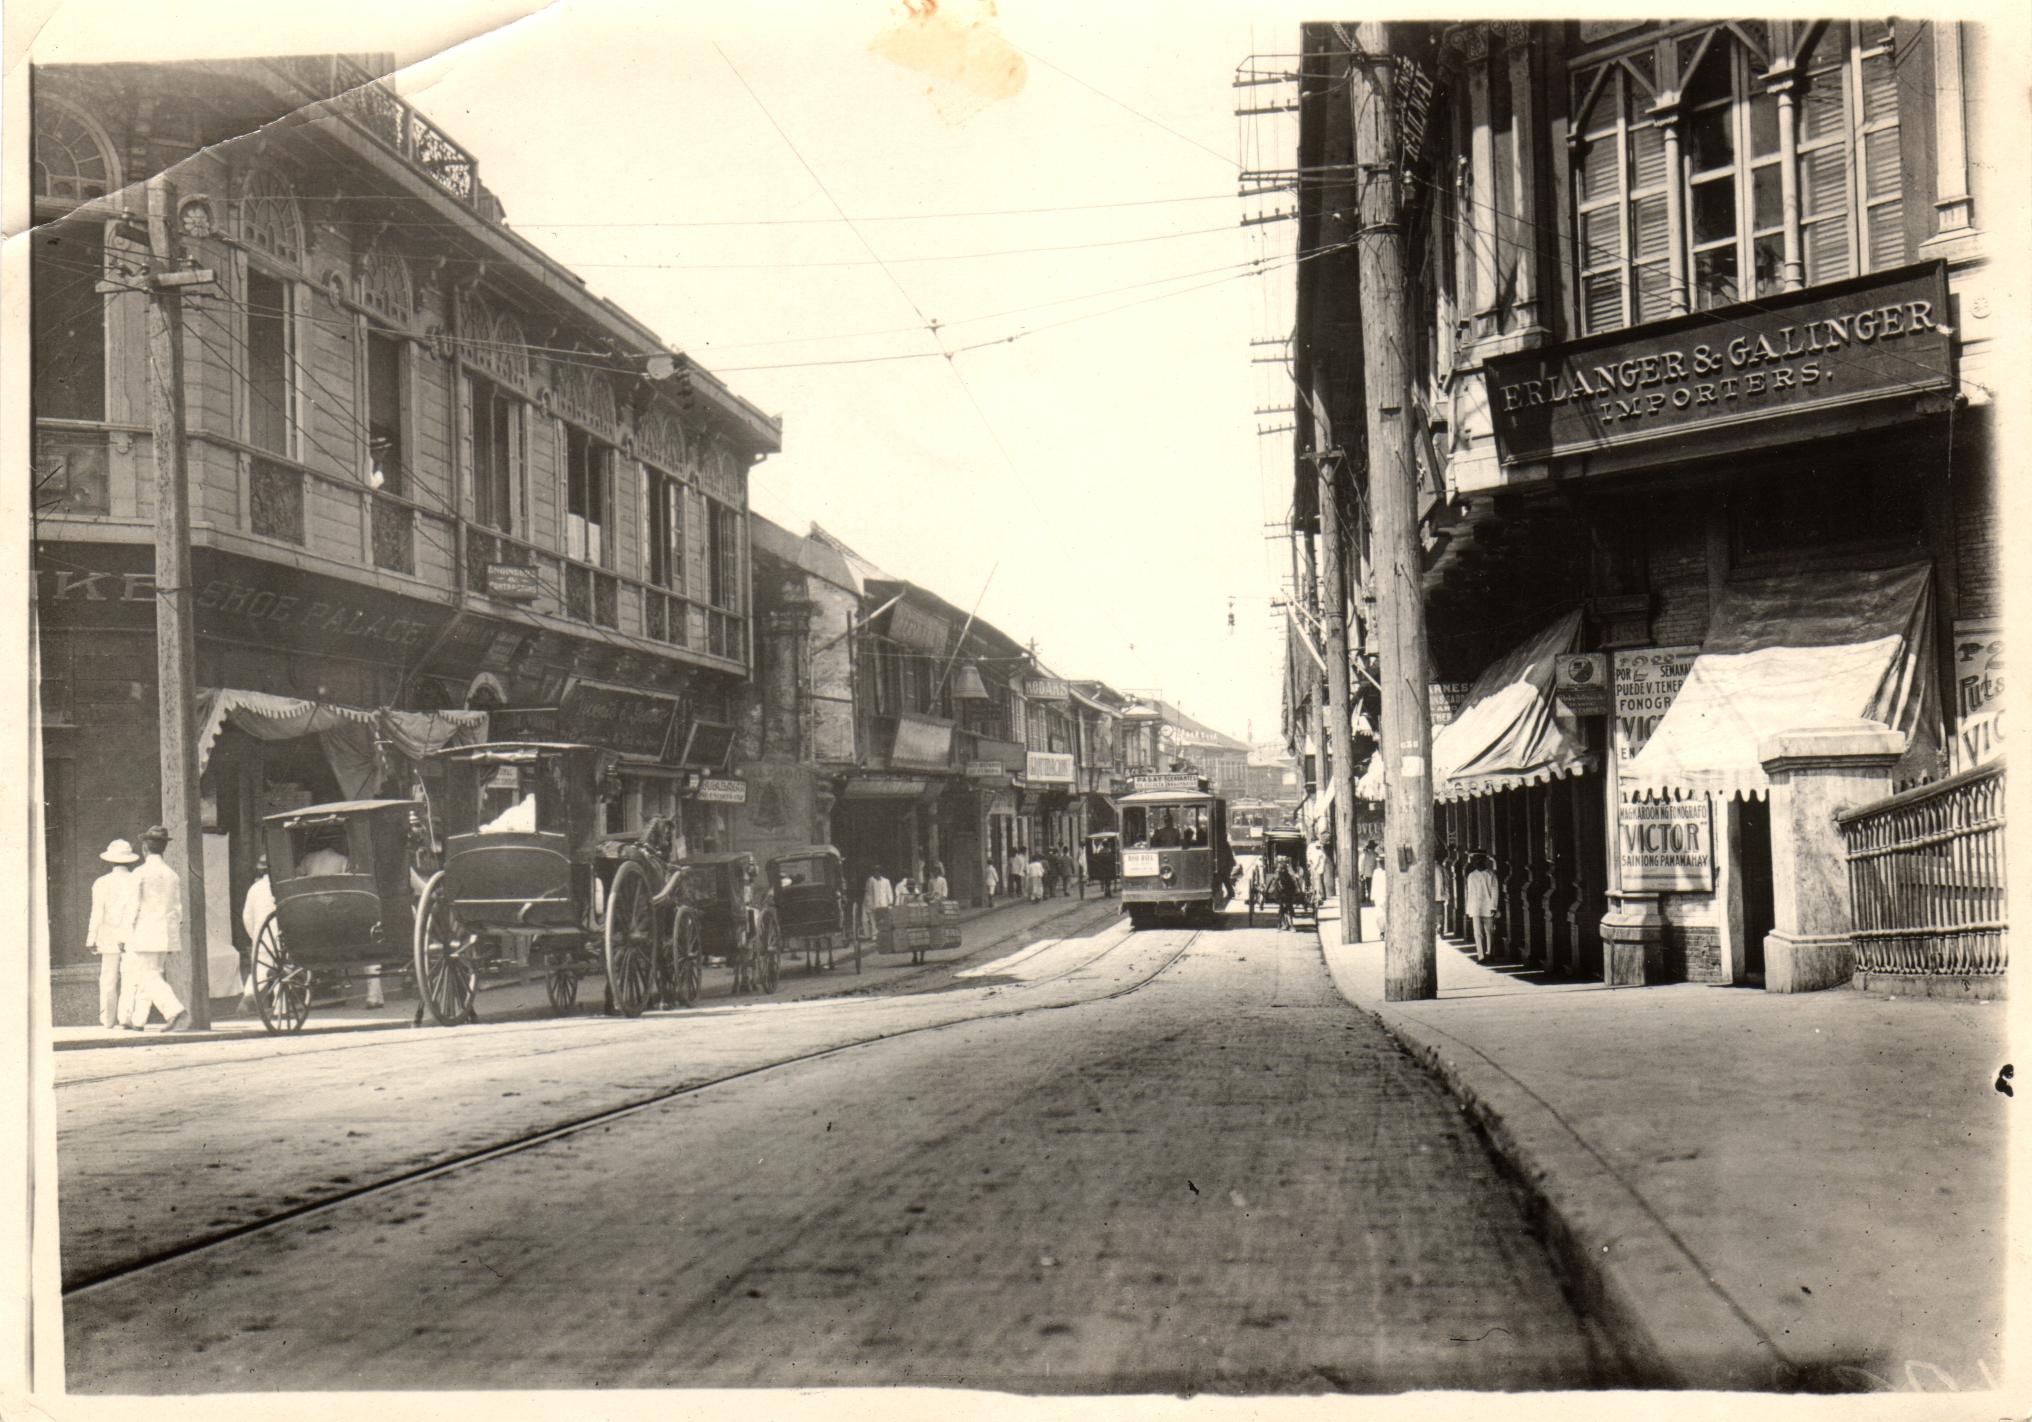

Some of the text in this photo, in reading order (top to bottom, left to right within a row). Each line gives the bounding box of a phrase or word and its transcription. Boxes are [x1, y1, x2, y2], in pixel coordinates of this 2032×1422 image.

[1501, 299, 1937, 412] ERLANGER & GALINGER
[1601, 361, 1834, 424] IMPORTERS.
[197, 580, 300, 622] SHOE
[302, 602, 427, 645] PALACE
[1025, 680, 1068, 697] KODAKS
[1616, 668, 1631, 681] POR
[1616, 683, 1645, 696] PUEDE
